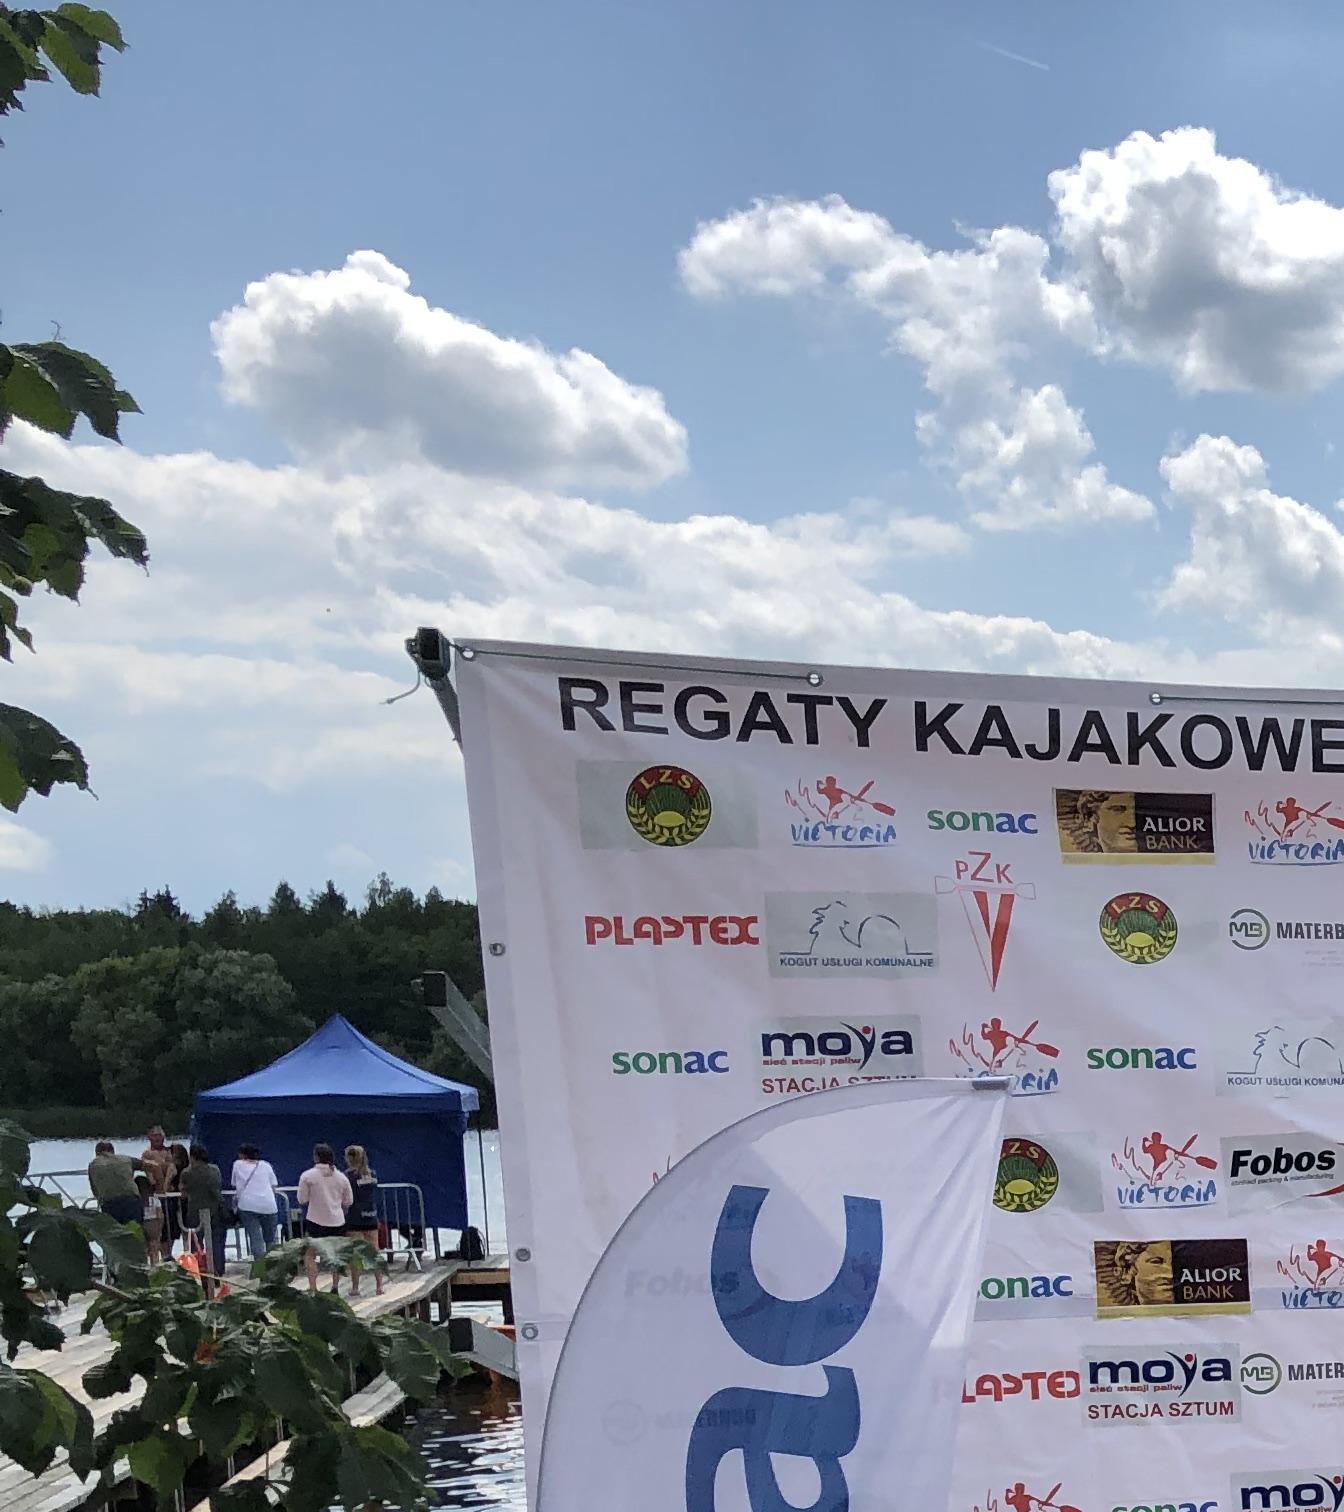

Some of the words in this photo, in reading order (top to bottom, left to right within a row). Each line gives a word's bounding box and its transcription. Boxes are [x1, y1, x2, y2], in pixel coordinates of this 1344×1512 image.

[557, 676, 888, 748] REGATY
[638, 767, 695, 791] LZS
[927, 808, 1039, 835] sonac
[1142, 816, 1206, 833] ALIOR
[1146, 834, 1198, 850] BANK
[955, 851, 1013, 884] PZK
[1110, 894, 1161, 914] LZS
[780, 957, 818, 968] KOGUT
[865, 957, 934, 968] KOMUNALNE
[762, 1021, 914, 1071] moya
[1087, 1045, 1197, 1071] sonac
[612, 1048, 730, 1076] sonac
[1227, 1076, 1263, 1087] KOGUT
[1230, 1146, 1336, 1178] Fobos
[976, 1273, 1073, 1299] onac
[1181, 1267, 1242, 1283] ALIOR
[1183, 1285, 1234, 1300] BANK
[1089, 1351, 1233, 1397] moya
[1087, 1402, 1164, 1420] STACJA
[1168, 1401, 1235, 1418] SZTUM
